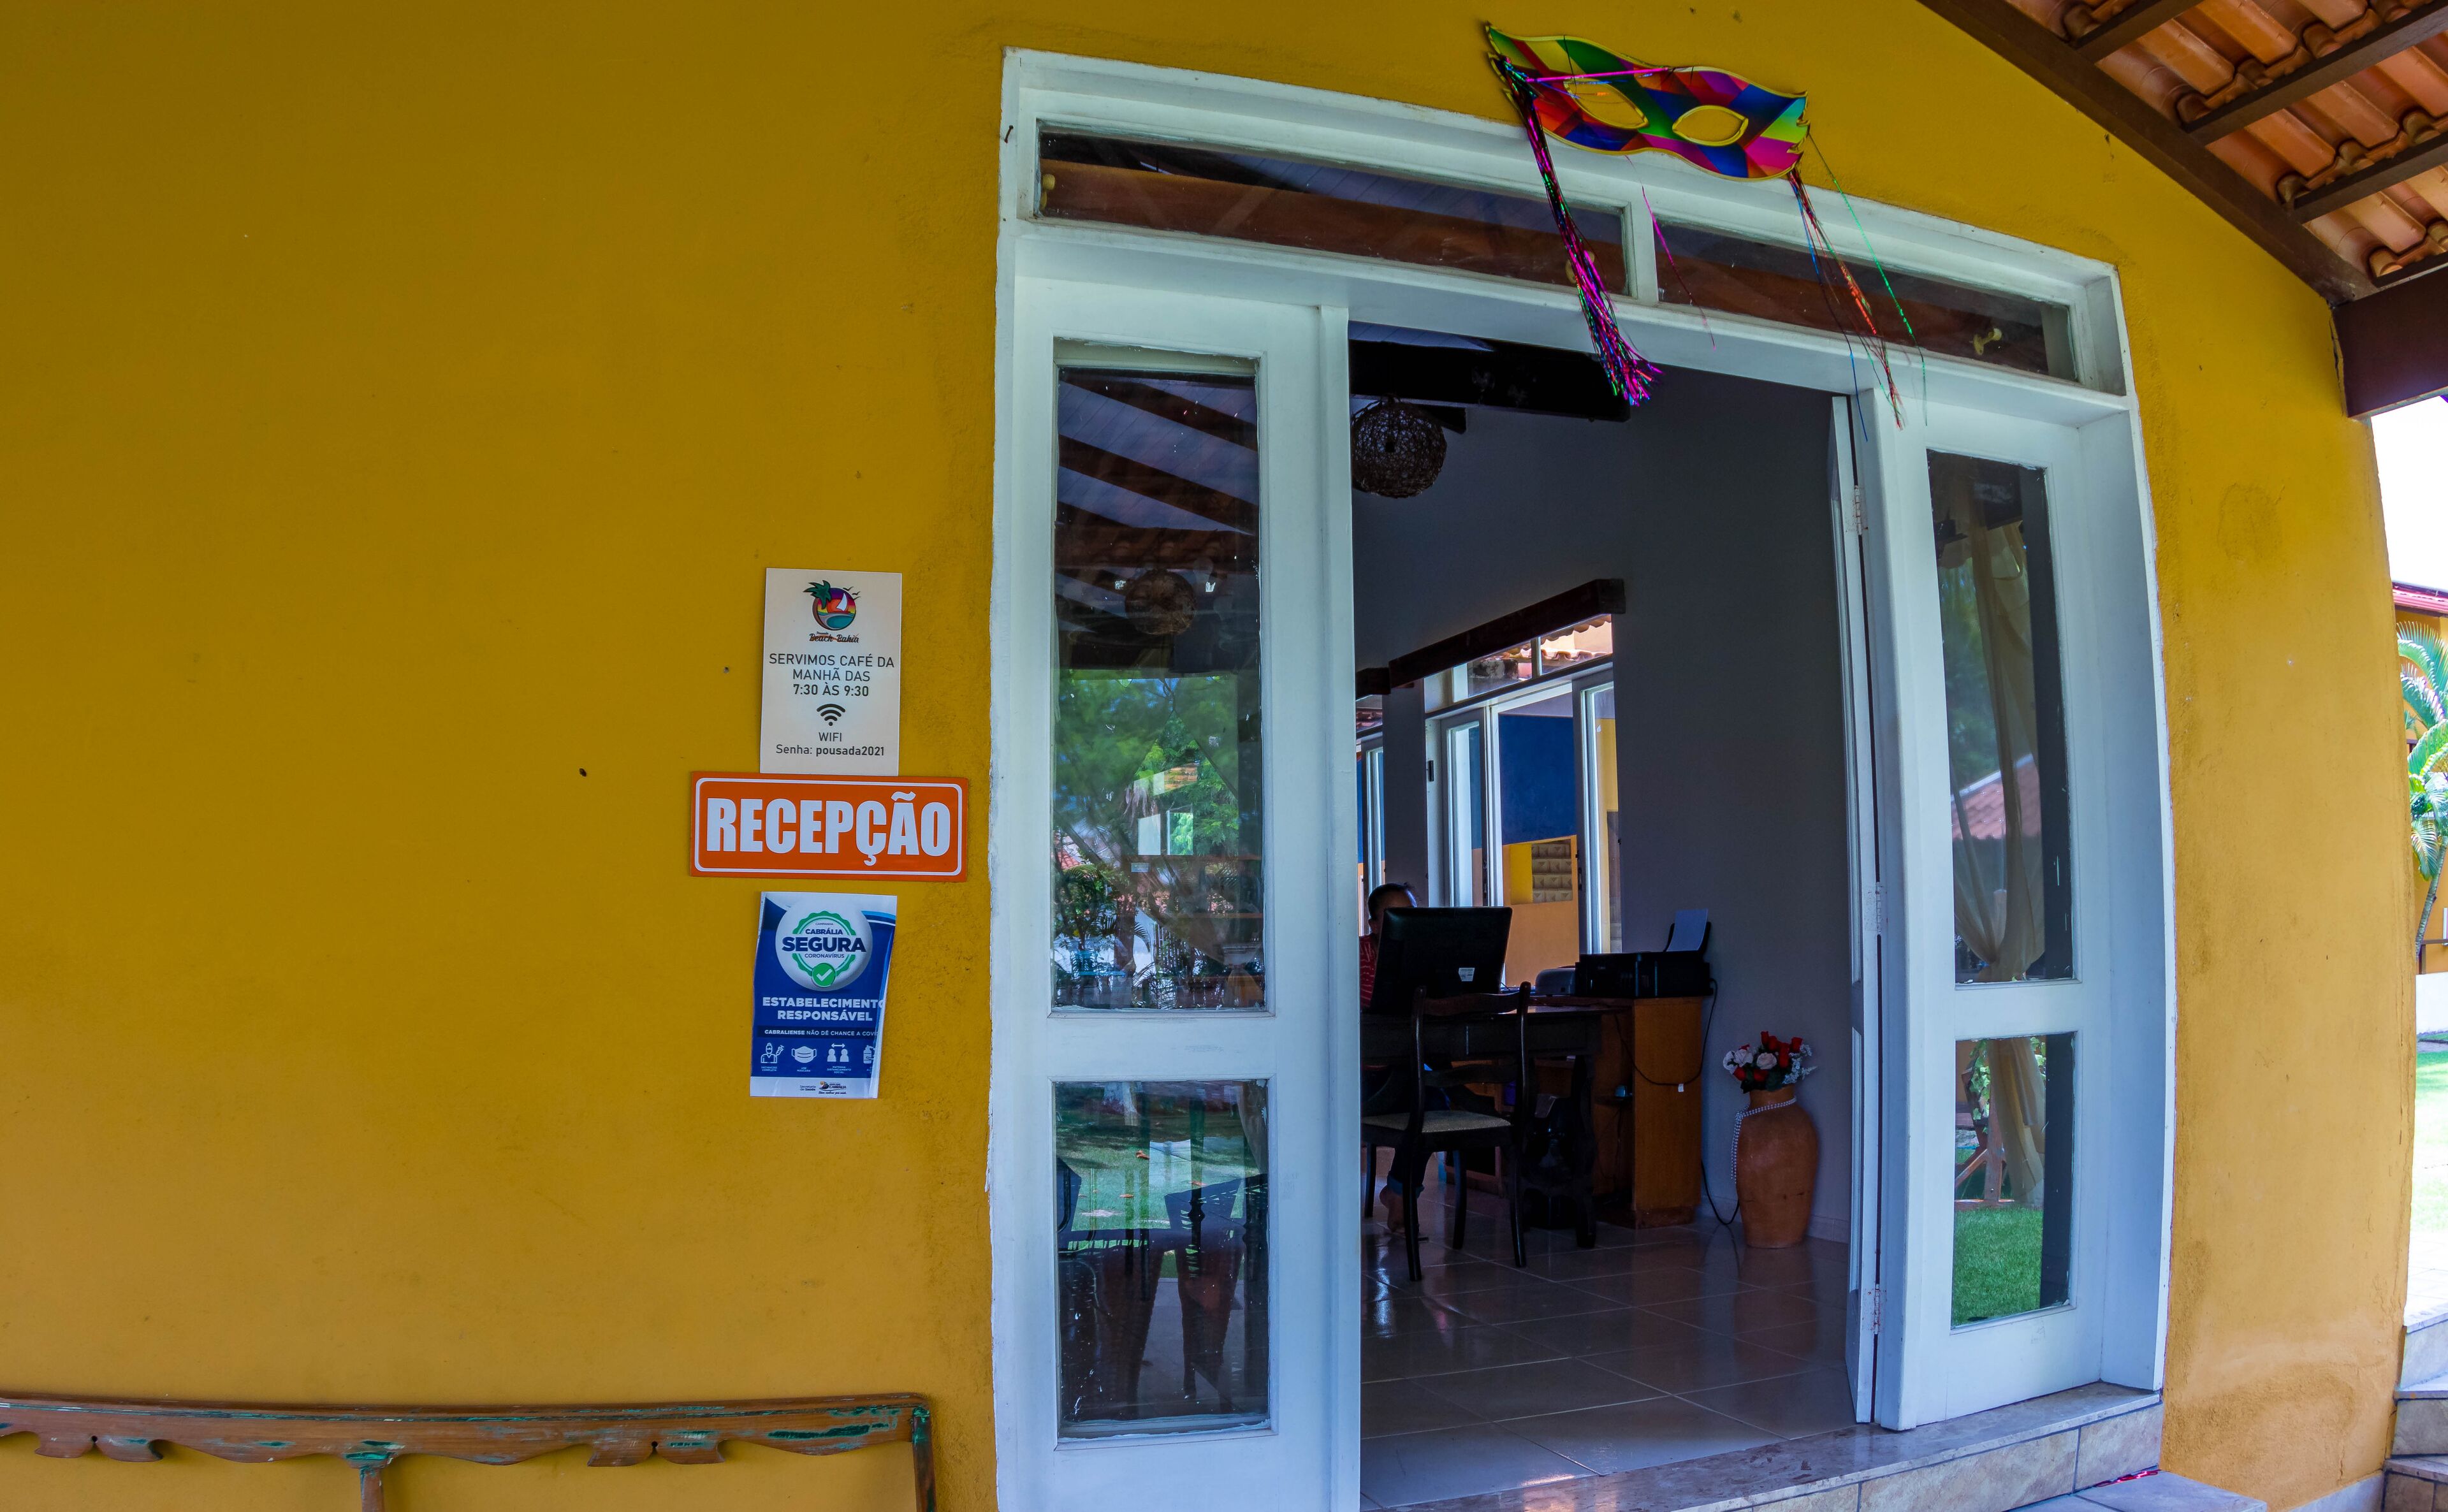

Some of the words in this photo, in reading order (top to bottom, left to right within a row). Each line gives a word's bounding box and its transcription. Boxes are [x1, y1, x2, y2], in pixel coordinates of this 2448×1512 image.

[809, 633, 833, 642] Beach
[769, 653, 835, 665] SERVIMOS
[840, 653, 873, 667] CAFÉ
[877, 657, 894, 668] DA
[792, 667, 841, 681] MANHÃ
[845, 671, 871, 681] DAS
[793, 683, 818, 695] 7:30
[822, 681, 840, 695] ÀS
[844, 685, 869, 697] 9:30
[819, 732, 842, 742] WIFI
[776, 744, 812, 754] Senha:
[816, 746, 884, 757] pousada2021
[706, 791, 951, 866] RECEPÇÃO
[782, 936, 867, 952] SEGURA
[777, 1009, 873, 1021] RESPONSÁVEL
